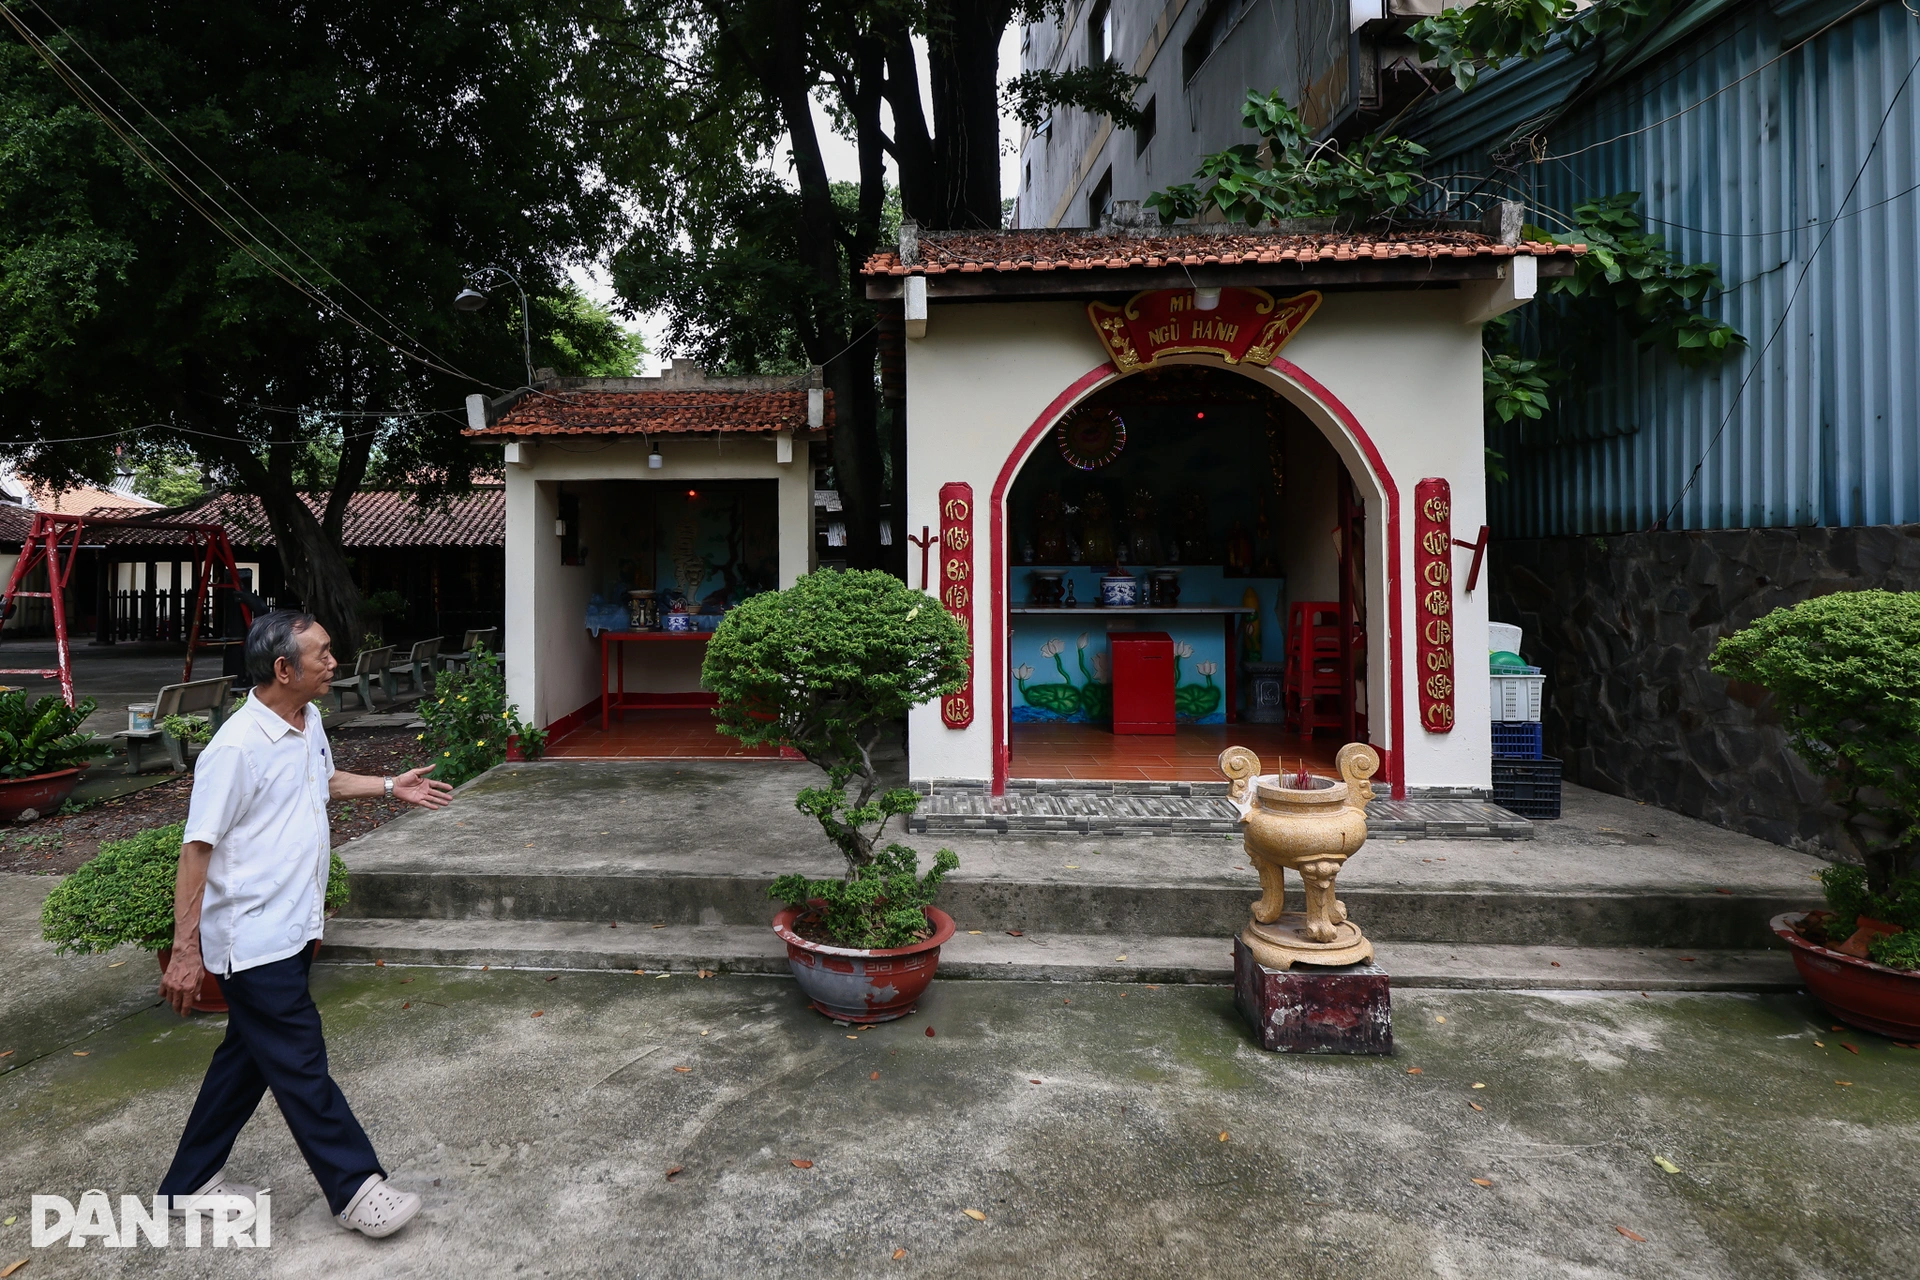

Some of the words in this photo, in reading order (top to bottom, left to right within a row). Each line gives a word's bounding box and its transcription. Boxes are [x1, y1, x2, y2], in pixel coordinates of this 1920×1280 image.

[1148, 317, 1180, 347] NGŨ
[1191, 315, 1239, 343] HÀNH
[1423, 496, 1449, 523] CÔNG
[1423, 529, 1448, 555] ĐỨC
[946, 558, 970, 581] BÁT
[945, 584, 969, 608] TIẾT
[1427, 647, 1452, 672] DÂN
[1428, 702, 1453, 726] MỘ
